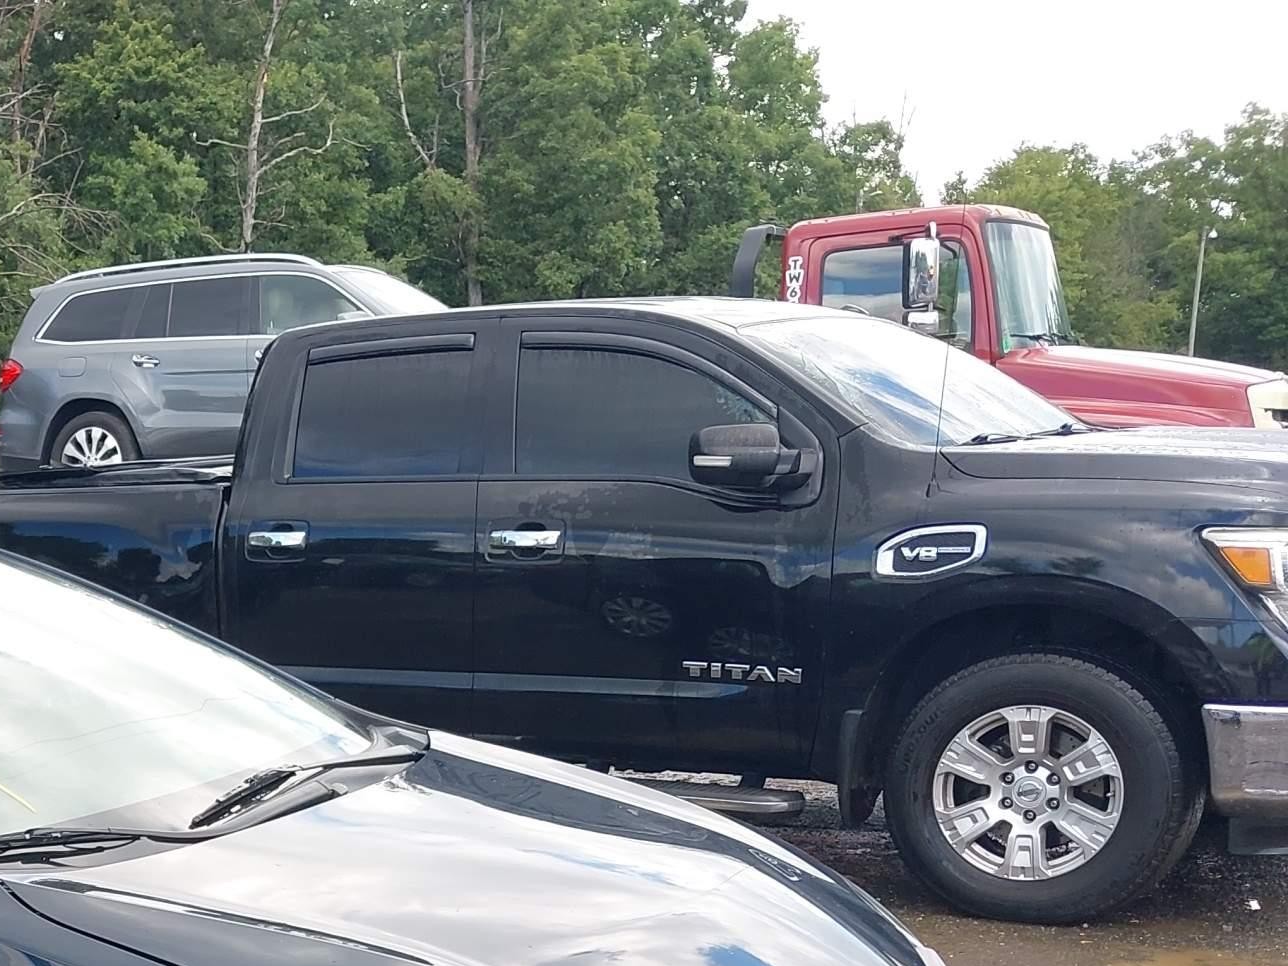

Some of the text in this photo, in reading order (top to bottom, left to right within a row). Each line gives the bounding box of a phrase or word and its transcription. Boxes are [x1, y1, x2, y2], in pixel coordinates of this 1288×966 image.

[787, 258, 802, 303] TW6
[900, 546, 937, 561] V8
[682, 660, 803, 684] TITAN
